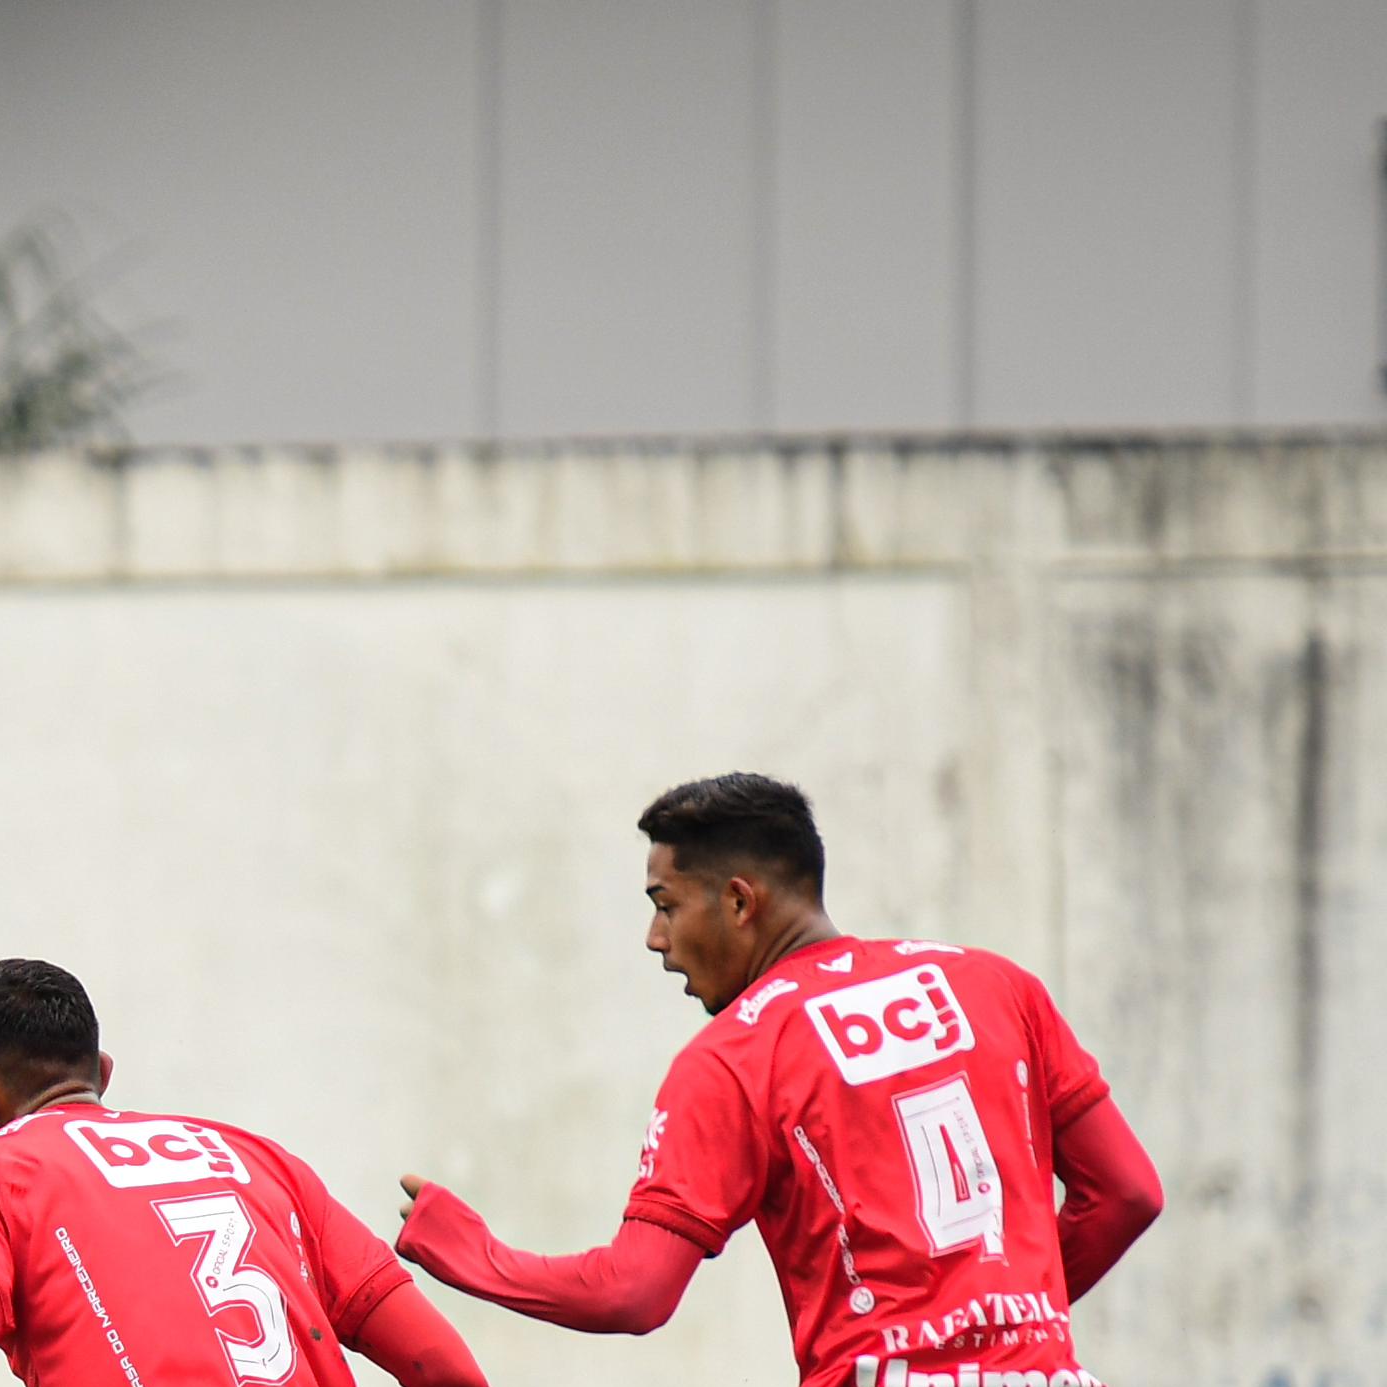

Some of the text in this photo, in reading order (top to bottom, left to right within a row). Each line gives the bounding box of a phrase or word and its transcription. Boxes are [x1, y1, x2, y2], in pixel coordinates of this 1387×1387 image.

[818, 971, 962, 1060] bcj
[76, 1123, 236, 1175] bcj
[891, 1069, 1010, 1267] 4
[54, 1226, 112, 1329] MARCENEIRO
[150, 1190, 298, 1387] 3
[106, 1328, 126, 1355] DO
